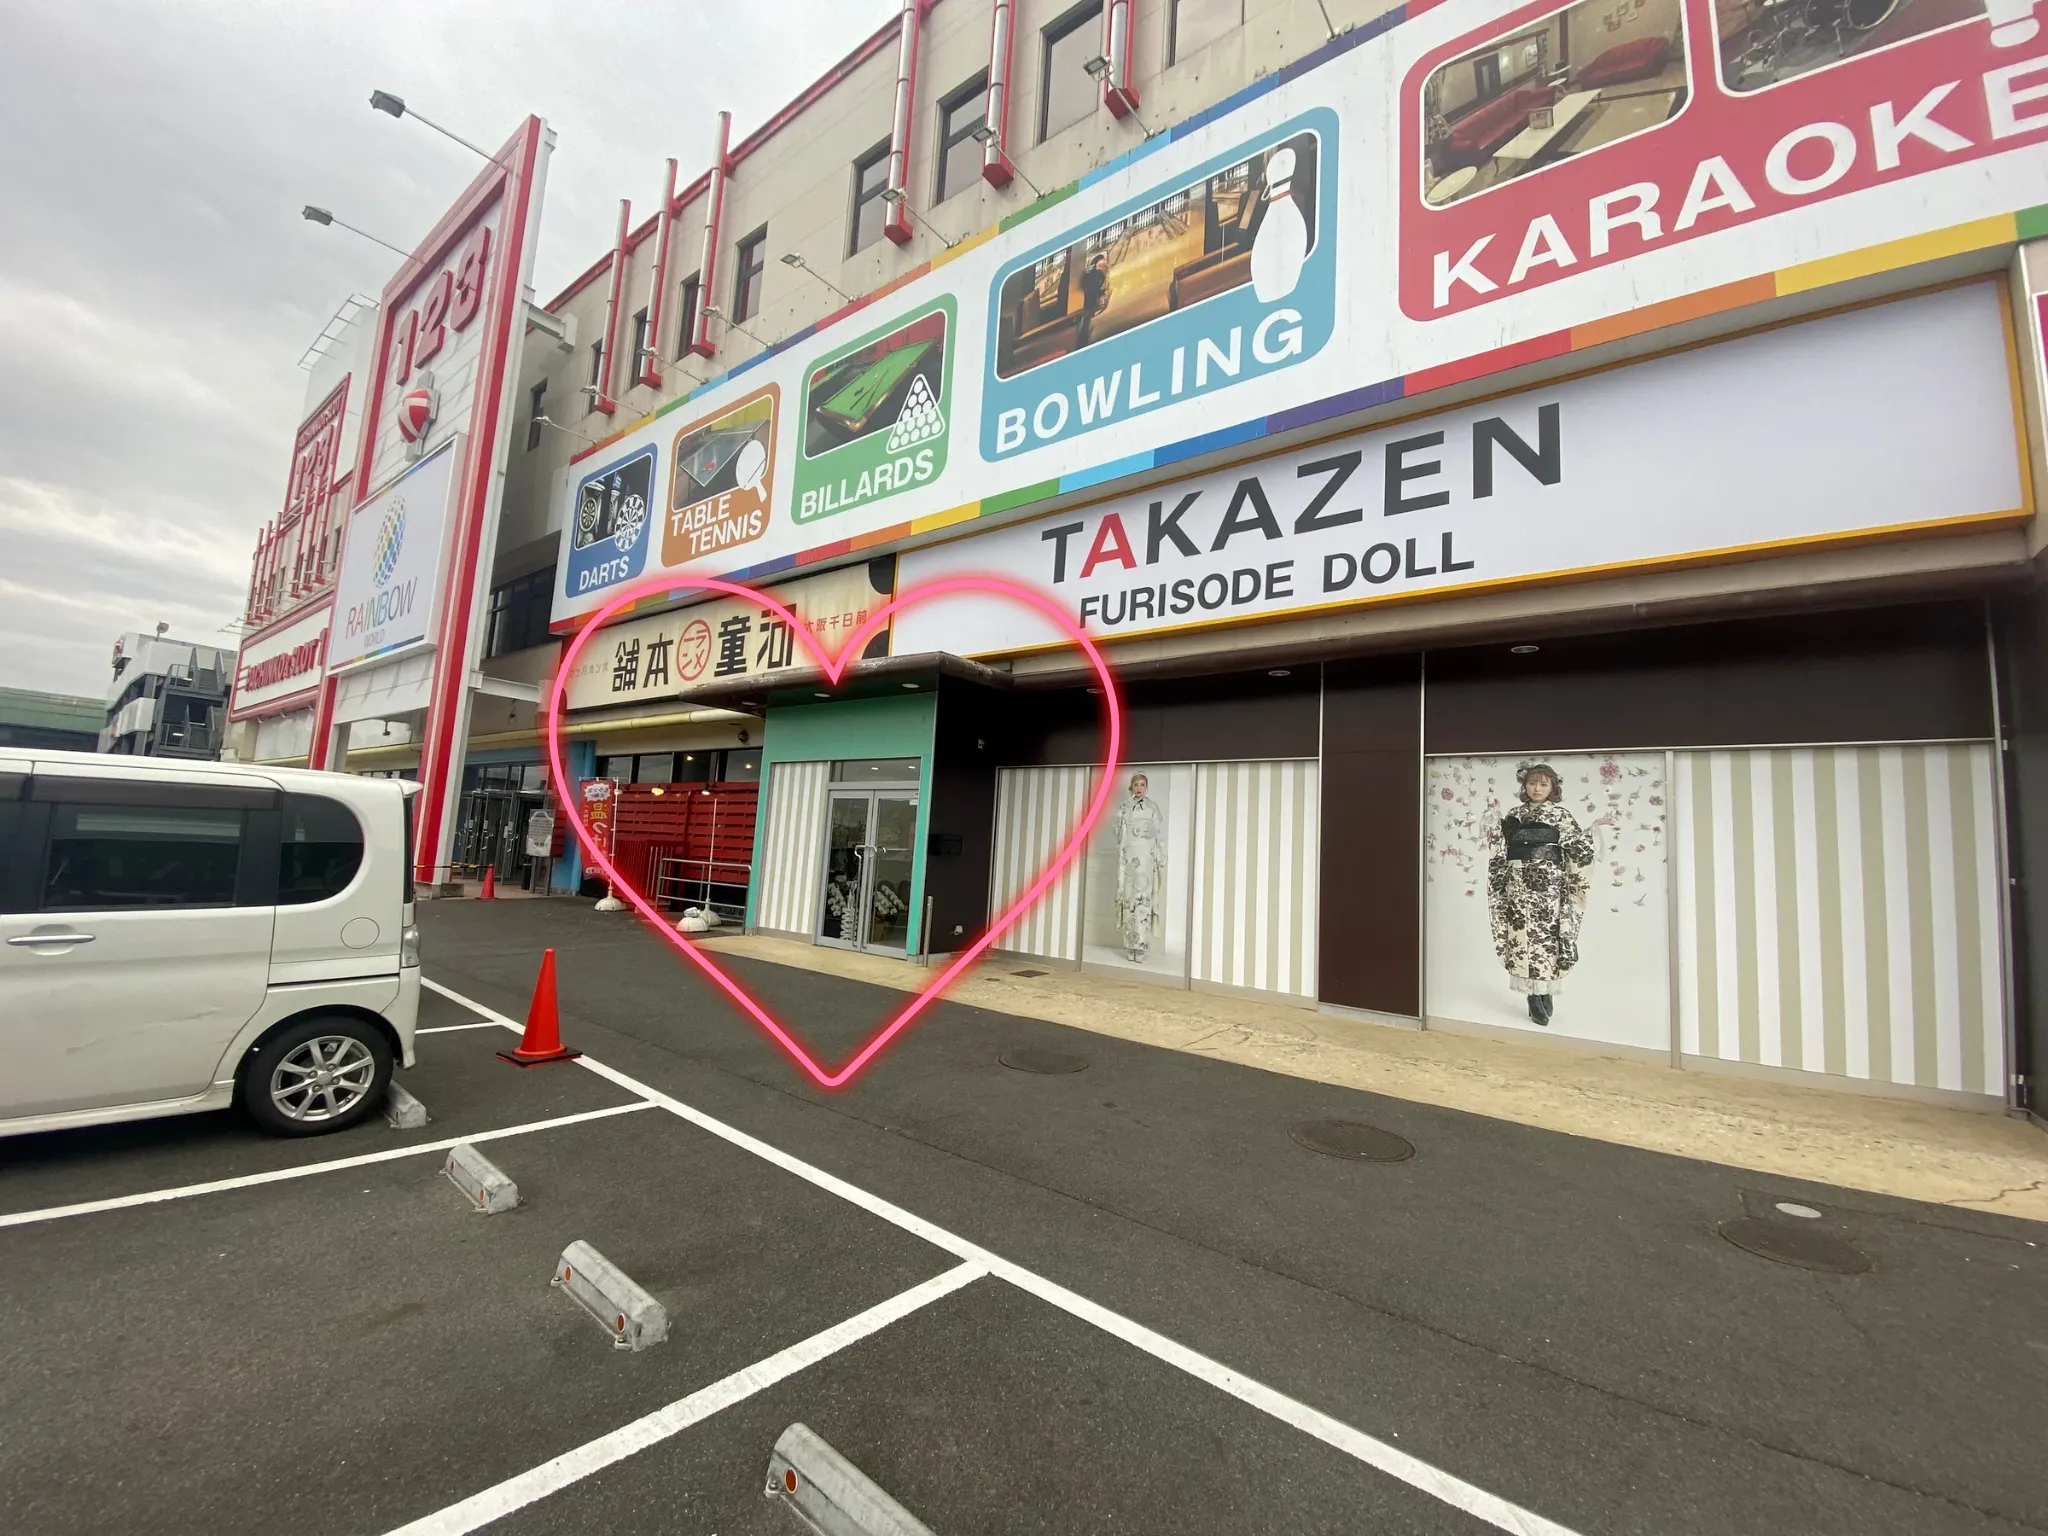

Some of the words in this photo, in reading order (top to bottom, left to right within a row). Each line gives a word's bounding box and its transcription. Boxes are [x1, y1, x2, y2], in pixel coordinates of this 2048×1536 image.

[1433, 54, 2048, 308] KARAOKE
[394, 225, 491, 386] 123
[995, 308, 1303, 454] BOWLING
[671, 494, 732, 537] TABLE
[800, 449, 934, 519] BILLARDS
[1041, 402, 1561, 583] TAKAZEN
[688, 509, 762, 555] TENNIS
[345, 576, 418, 640] RAINBOW
[579, 555, 630, 591] DARTS
[1079, 560, 1294, 628] FURISODE
[1323, 531, 1475, 593] DOLL
[364, 629, 385, 648] WORLD
